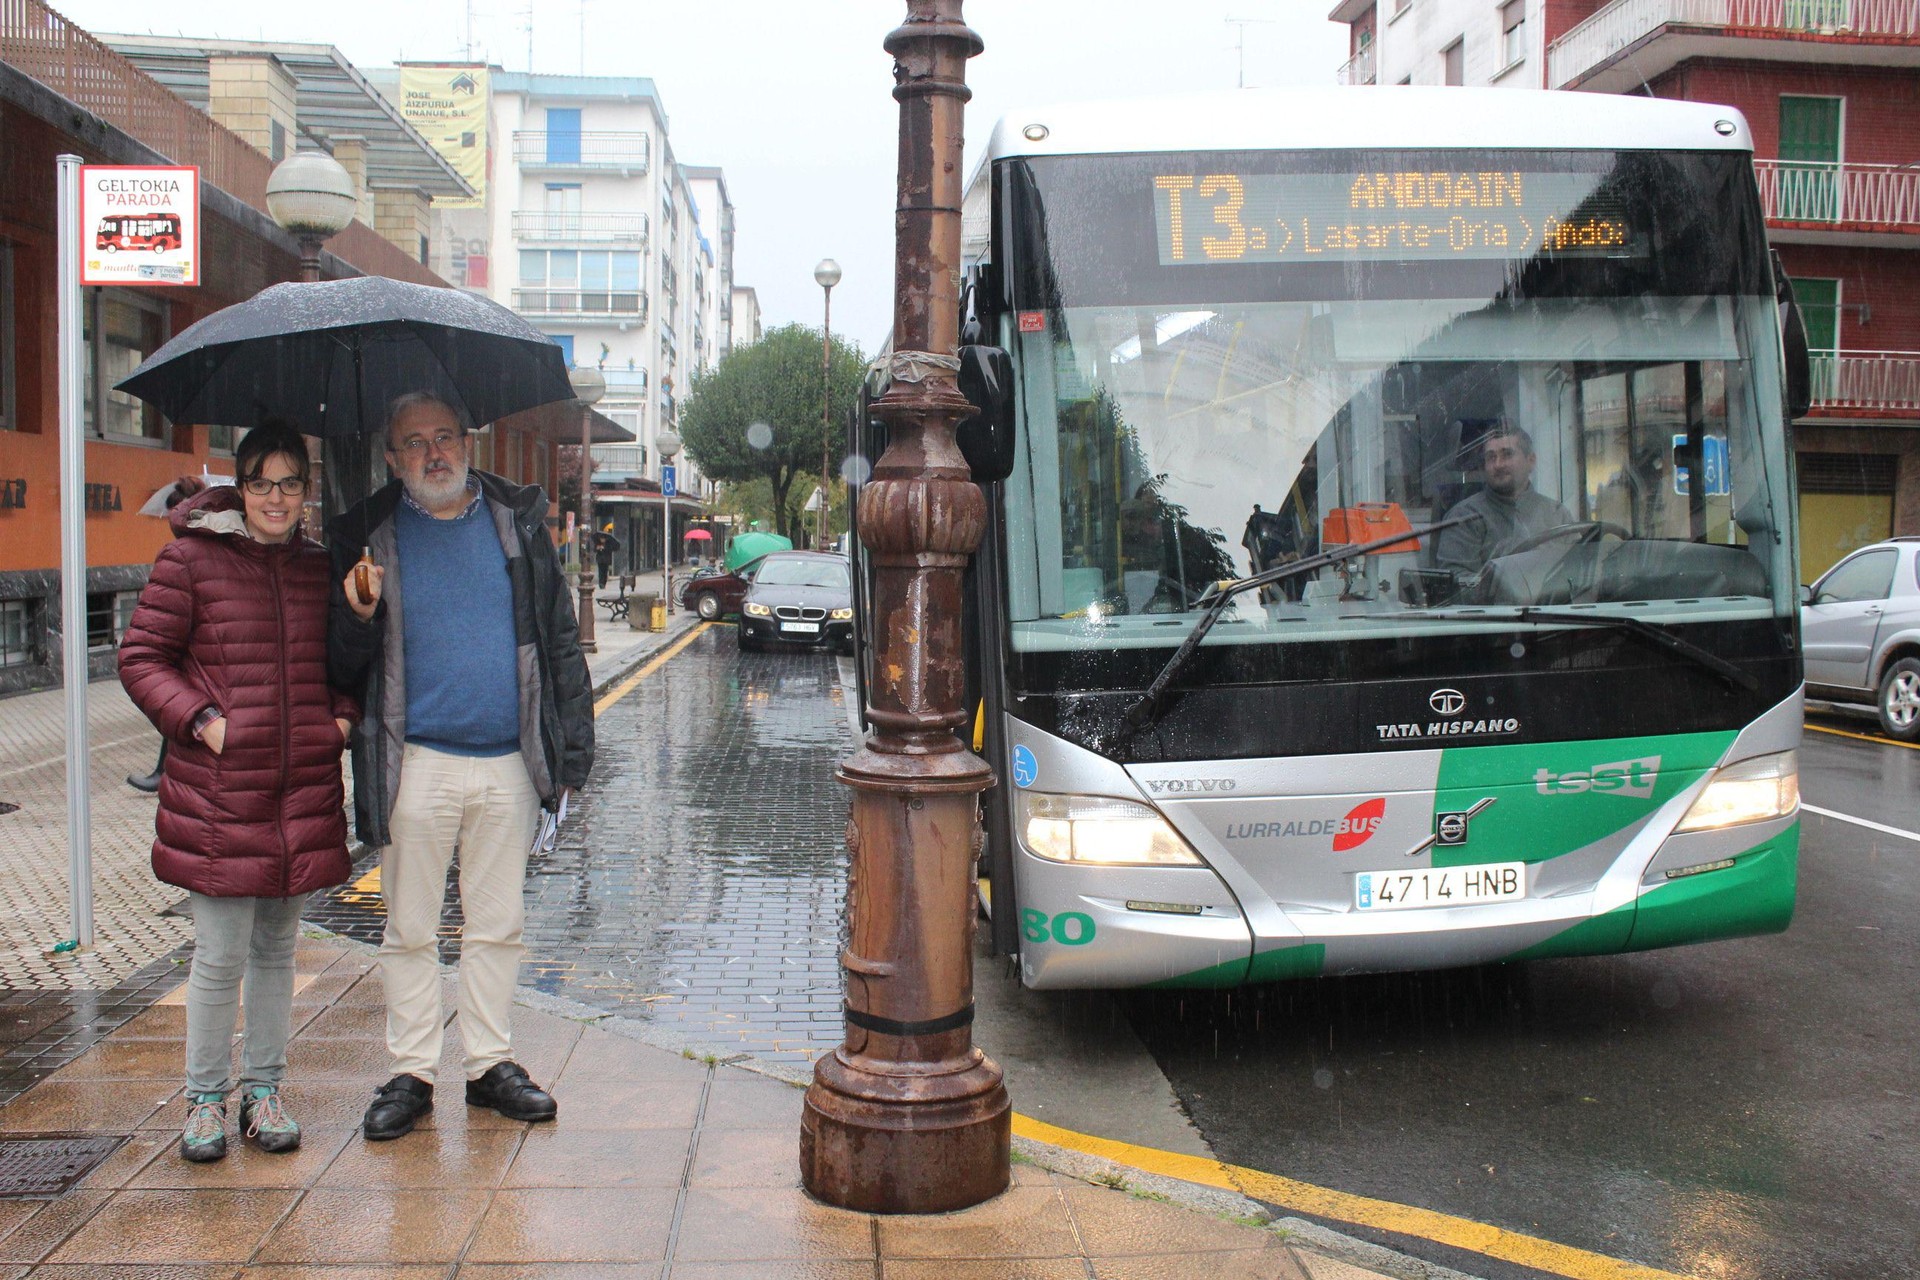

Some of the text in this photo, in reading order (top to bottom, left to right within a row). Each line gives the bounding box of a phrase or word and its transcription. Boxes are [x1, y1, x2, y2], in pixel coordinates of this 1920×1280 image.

[97, 179, 180, 192] GELTOKIA
[1351, 172, 1522, 208] ANDOAIN
[106, 193, 172, 206] PARADA
[1155, 174, 1247, 259] T3
[1376, 718, 1519, 739] TATA HISPANO
[1145, 778, 1236, 793] VOLVO
[1378, 873, 1453, 903] 4714
[1465, 868, 1518, 898] HNB
